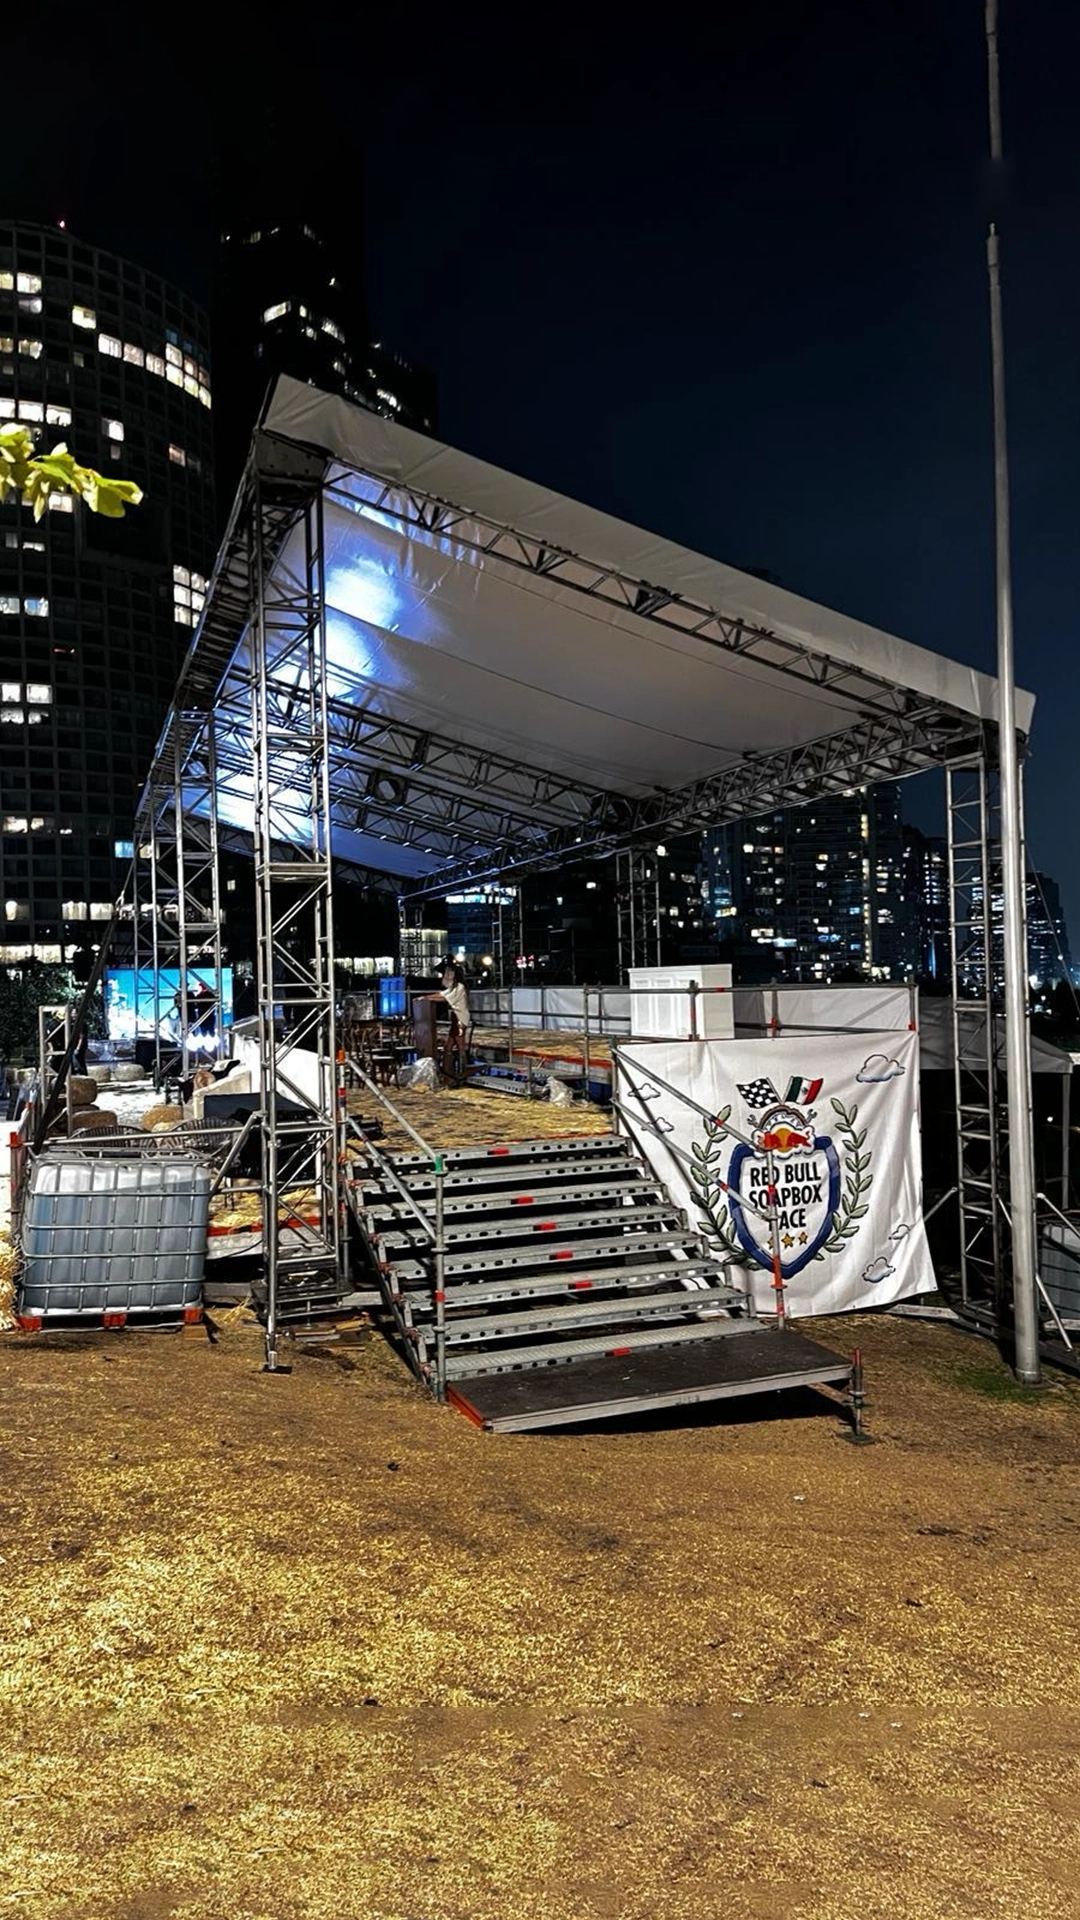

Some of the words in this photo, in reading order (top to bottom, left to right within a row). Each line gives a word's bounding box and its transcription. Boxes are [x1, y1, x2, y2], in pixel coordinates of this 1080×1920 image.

[750, 1166, 780, 1187] RED
[785, 1162, 821, 1183] BULL
[769, 1208, 806, 1231] ACE
